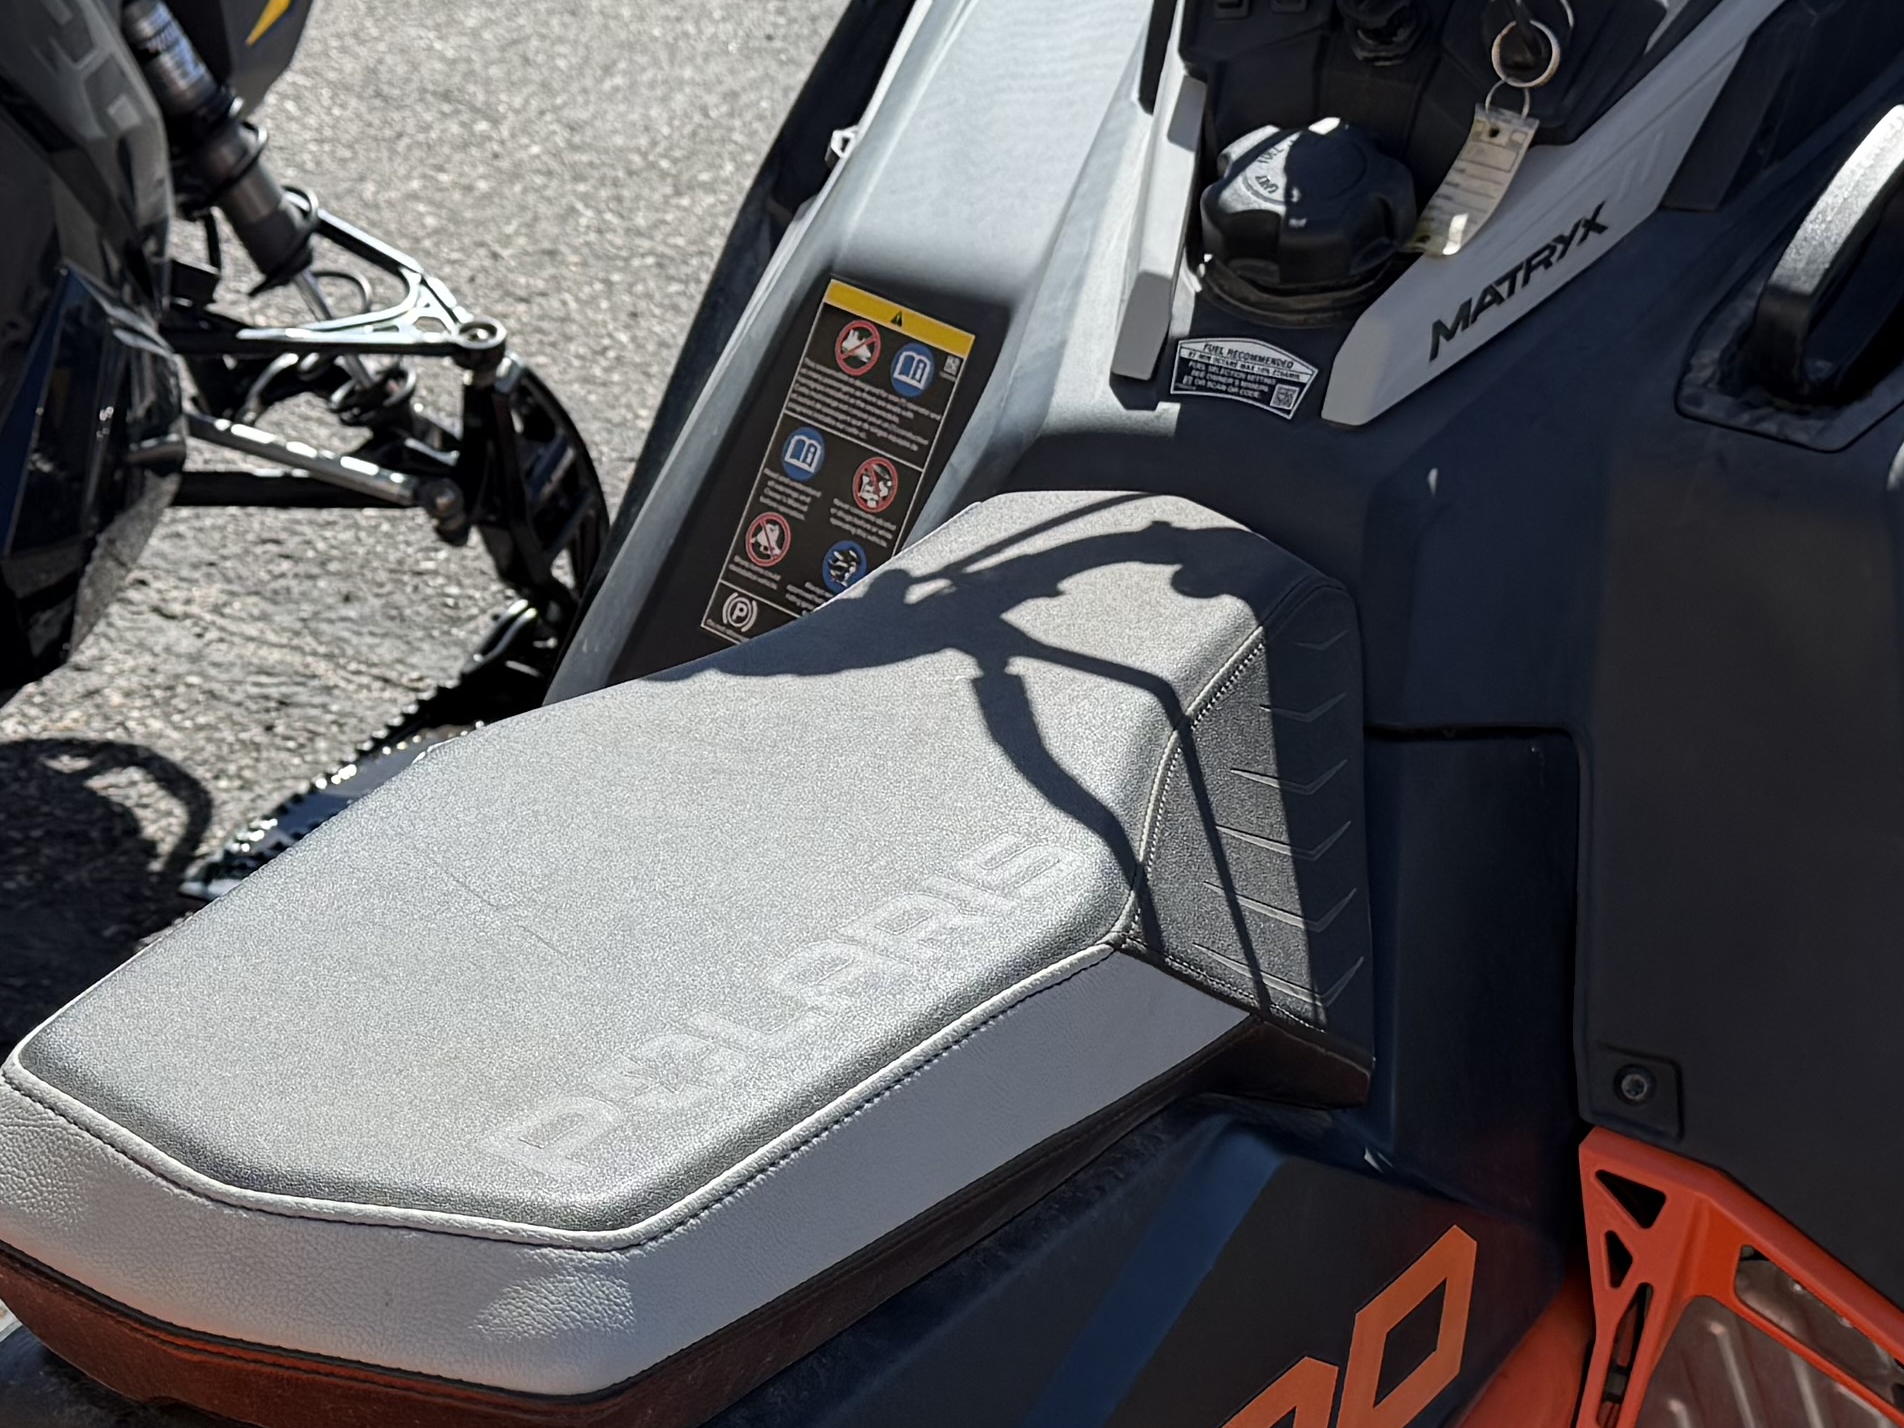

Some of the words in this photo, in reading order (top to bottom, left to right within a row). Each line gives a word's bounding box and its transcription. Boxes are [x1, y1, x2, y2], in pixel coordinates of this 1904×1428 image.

[1203, 343, 1224, 356] FUEL
[1227, 348, 1294, 369] RECOMMENDED
[1429, 199, 1609, 362] MATRYX
[484, 834, 1089, 1176] POLARIS
